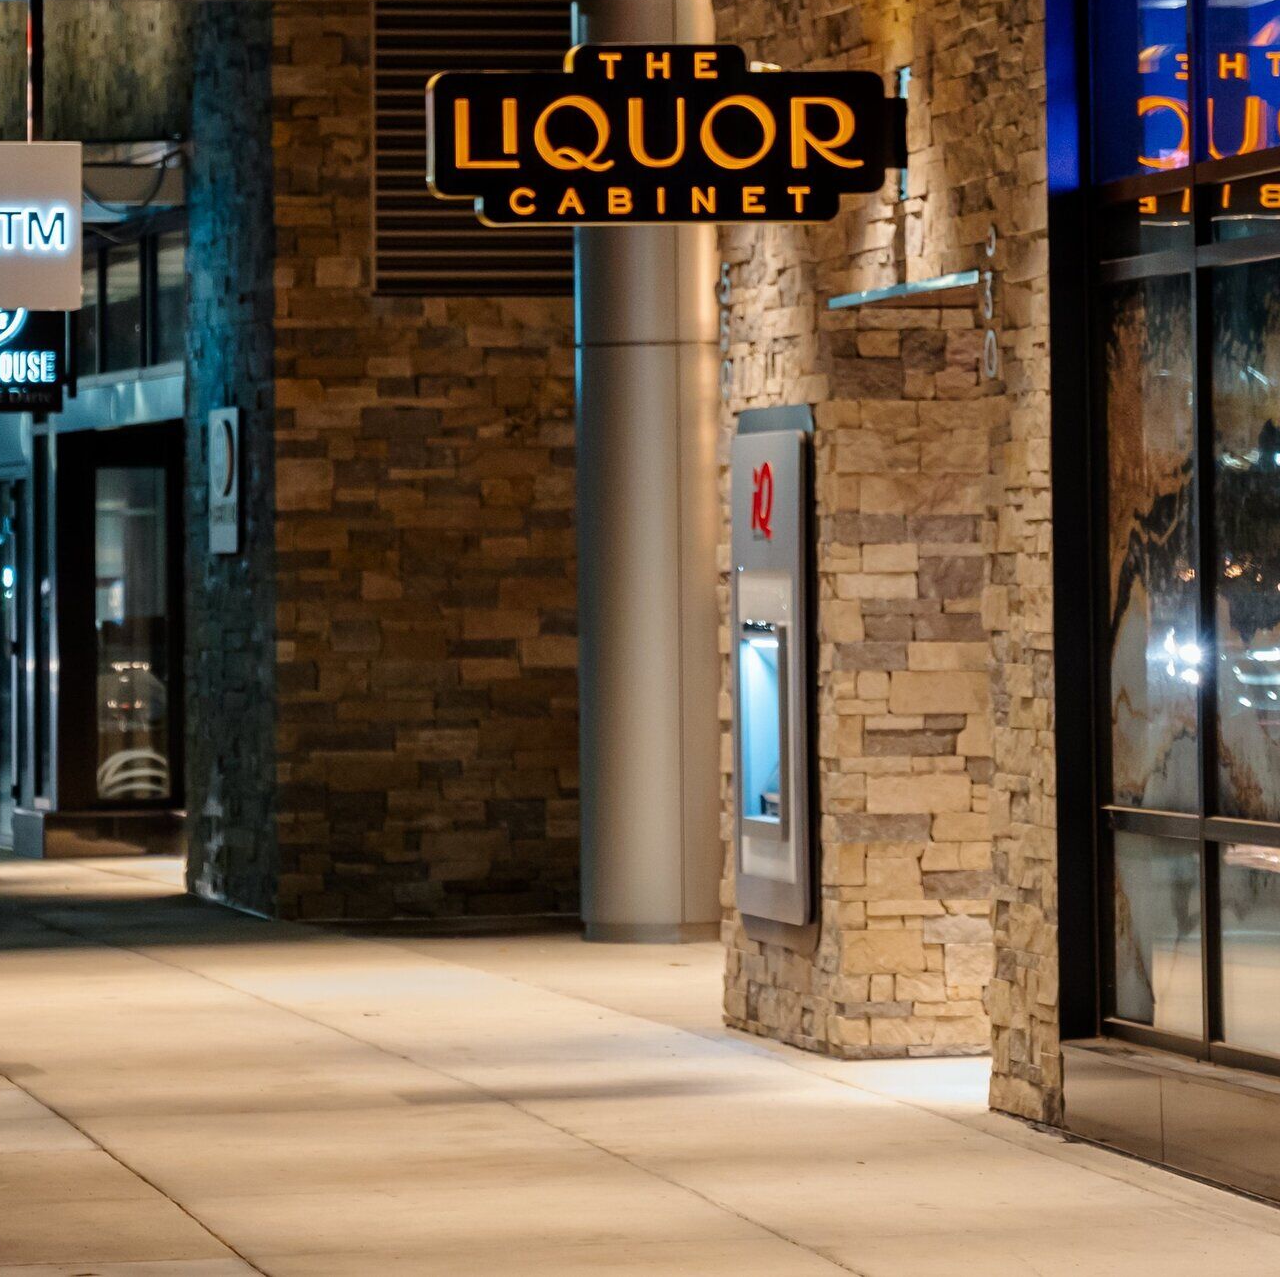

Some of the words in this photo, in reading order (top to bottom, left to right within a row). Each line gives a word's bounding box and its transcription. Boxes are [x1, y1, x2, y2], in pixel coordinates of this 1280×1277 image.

[598, 51, 719, 80] THE
[453, 94, 865, 173] LIQUOR
[508, 185, 812, 215] CABINET
